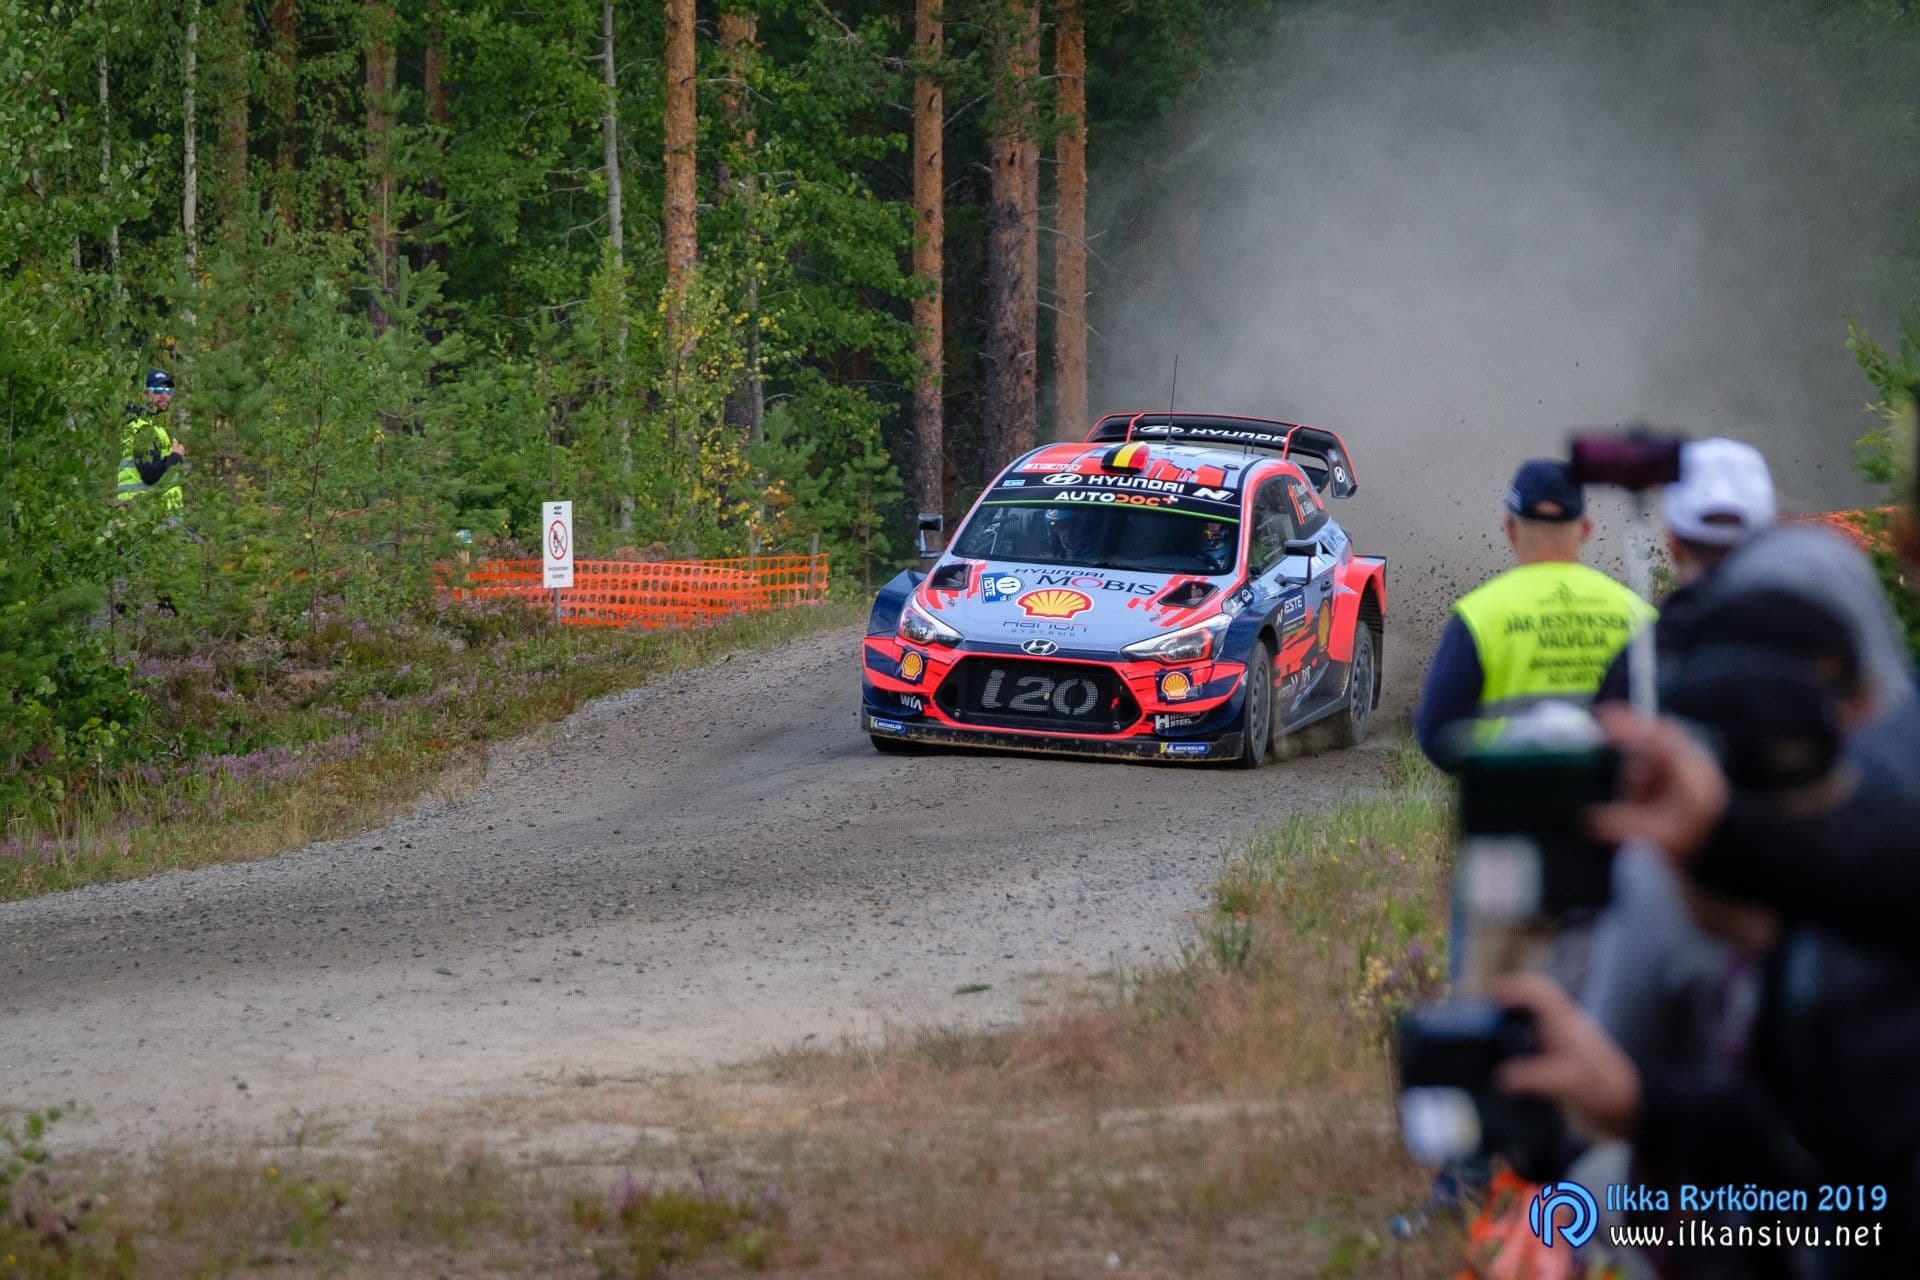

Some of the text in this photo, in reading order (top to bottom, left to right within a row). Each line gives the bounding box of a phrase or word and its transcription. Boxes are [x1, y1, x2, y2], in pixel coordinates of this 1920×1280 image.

[1191, 428, 1288, 443] HYUNDA
[1088, 475, 1185, 494] HYUNDAI
[1014, 567, 1105, 578] HYUNDAI
[1036, 574, 1158, 596] MOBIS
